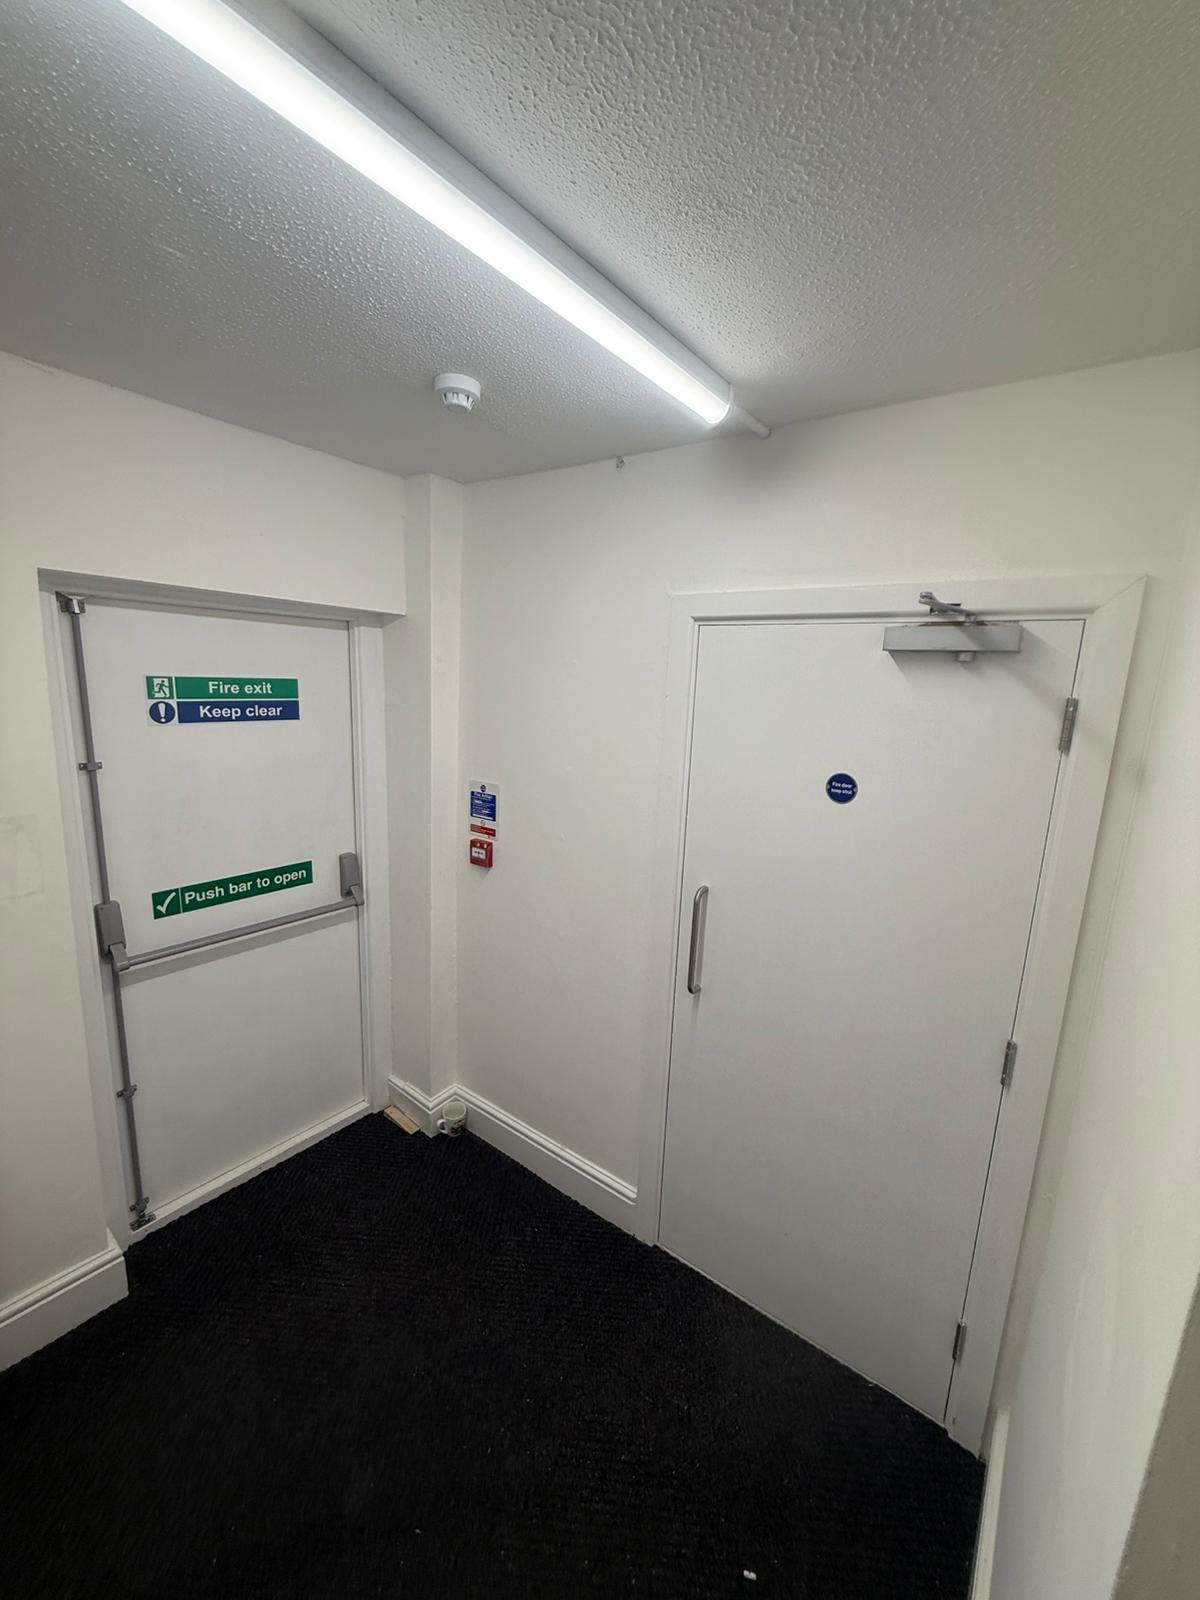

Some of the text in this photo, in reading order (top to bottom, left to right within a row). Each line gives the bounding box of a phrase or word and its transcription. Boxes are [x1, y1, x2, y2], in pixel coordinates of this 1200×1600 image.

[208, 681, 273, 694] Fire exit
[199, 705, 283, 719] Keep clear
[184, 869, 307, 904] Push bar to open
